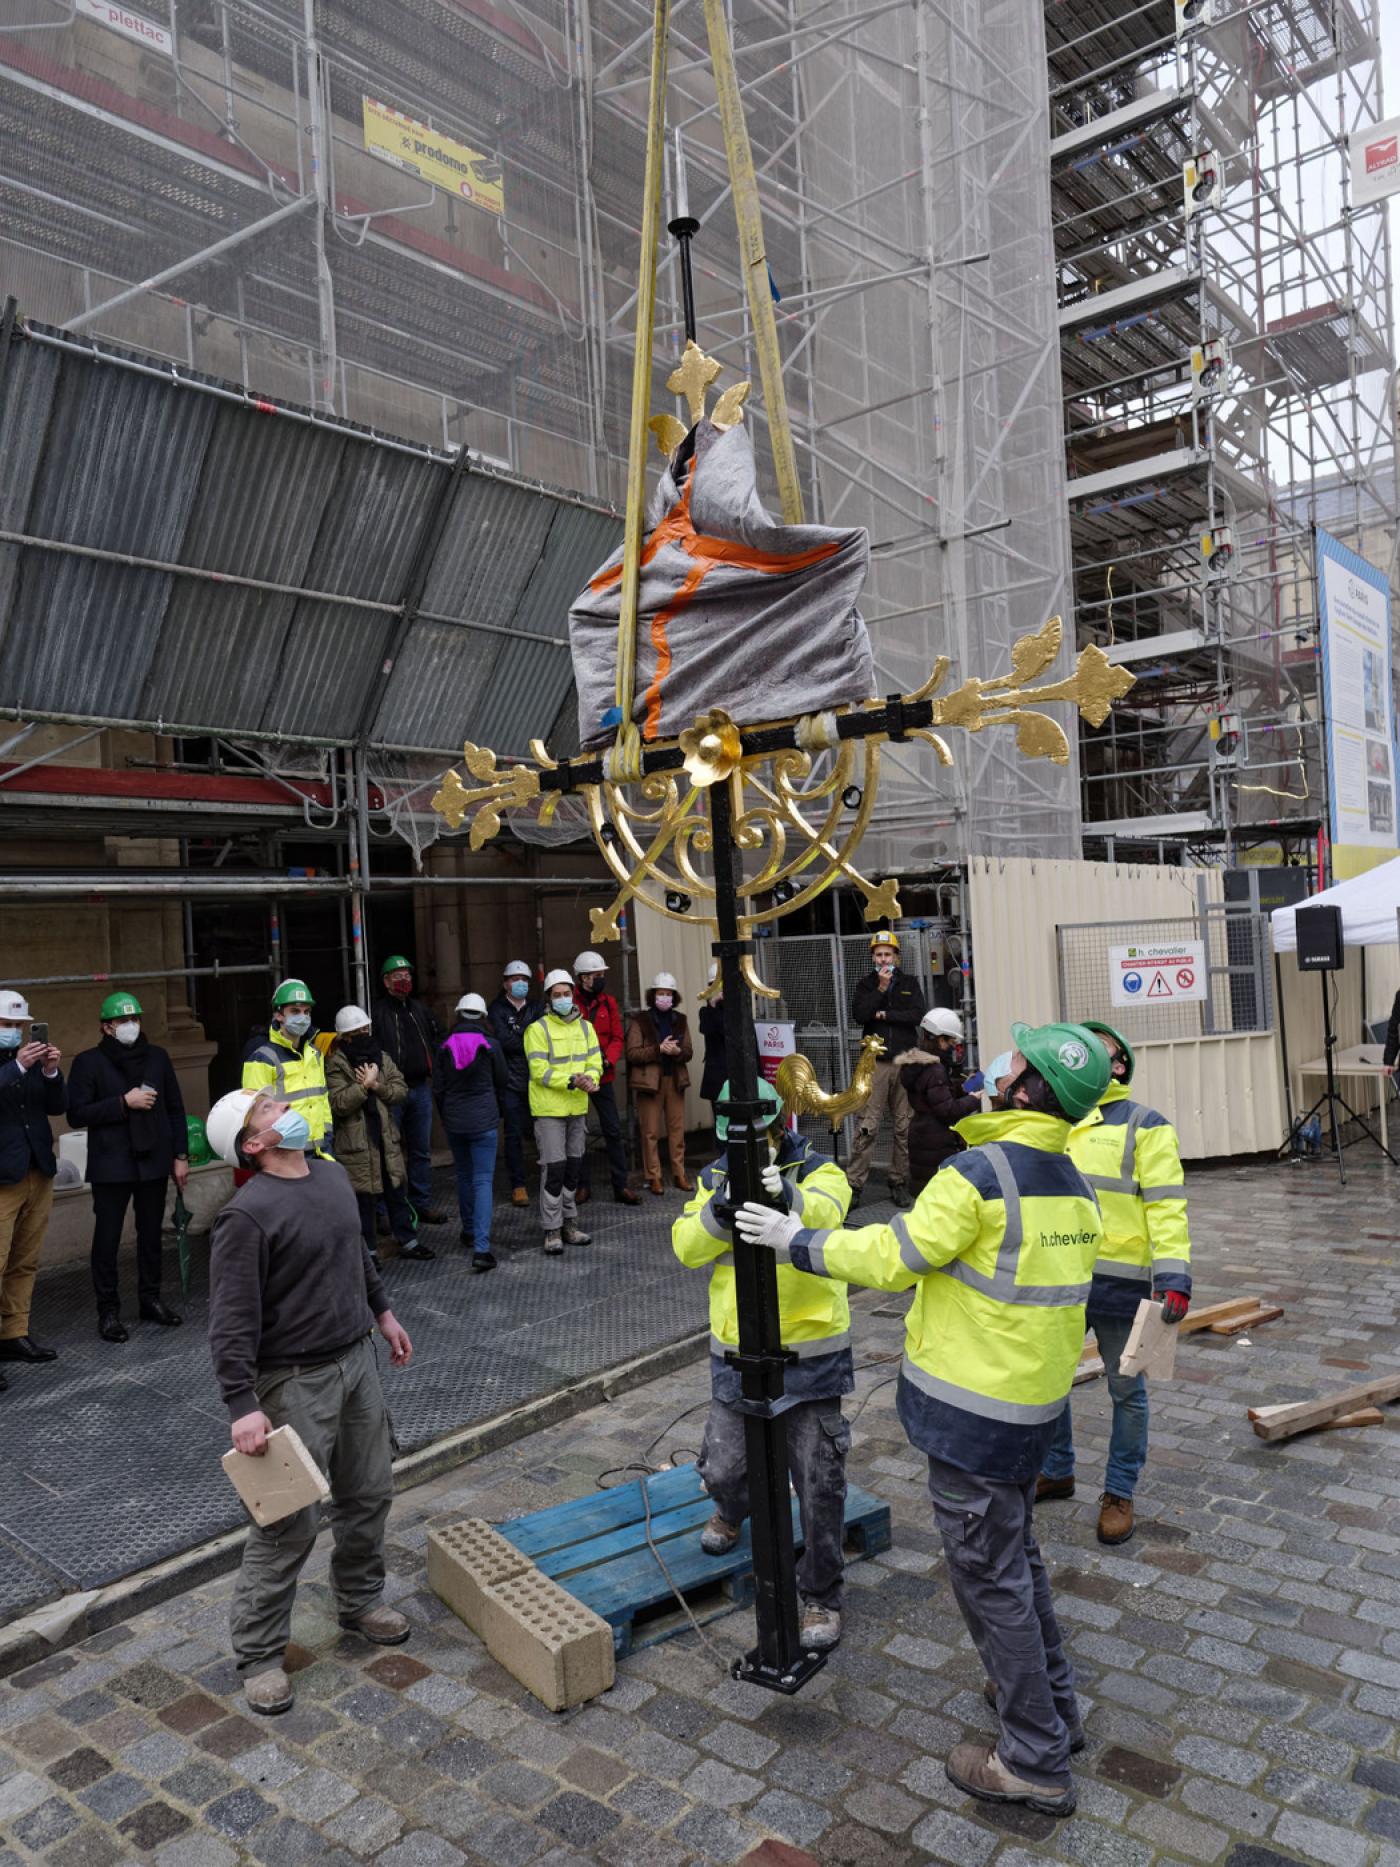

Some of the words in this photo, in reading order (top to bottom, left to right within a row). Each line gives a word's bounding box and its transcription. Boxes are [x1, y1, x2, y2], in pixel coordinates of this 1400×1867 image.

[109, 8, 164, 43] plettac
[414, 139, 468, 175] prodomo
[1368, 155, 1396, 172] ALTRAD
[1148, 946, 1186, 957] chevalier
[763, 1039, 785, 1049] PARIS
